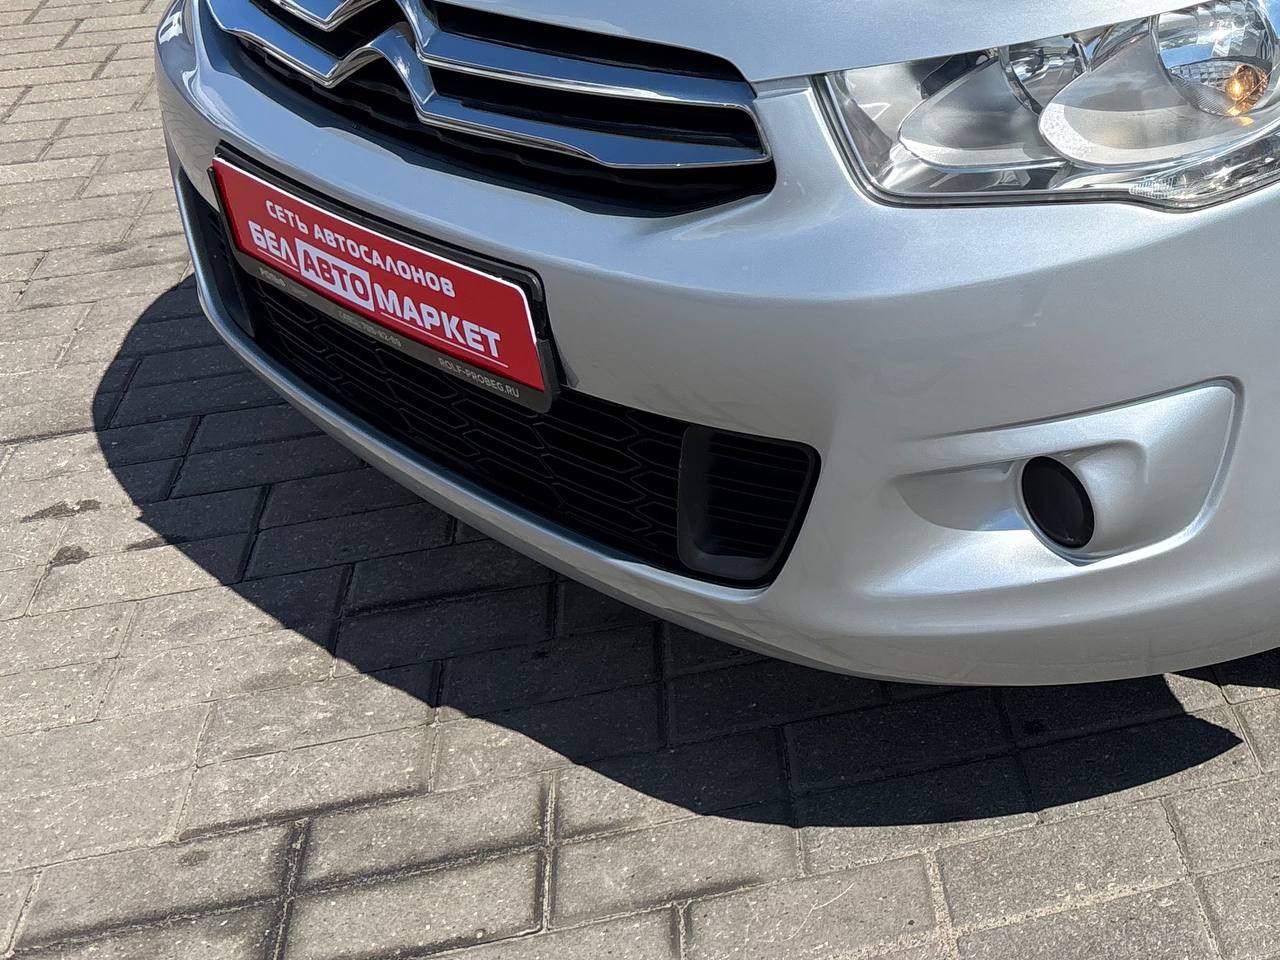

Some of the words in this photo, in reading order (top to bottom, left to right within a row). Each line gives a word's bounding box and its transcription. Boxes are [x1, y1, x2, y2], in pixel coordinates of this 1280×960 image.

[264, 198, 309, 237] СЕТЬ
[313, 222, 456, 298] АВТОСАЛОНОВ
[437, 356, 521, 399] ROLF-PROBEG.RU
